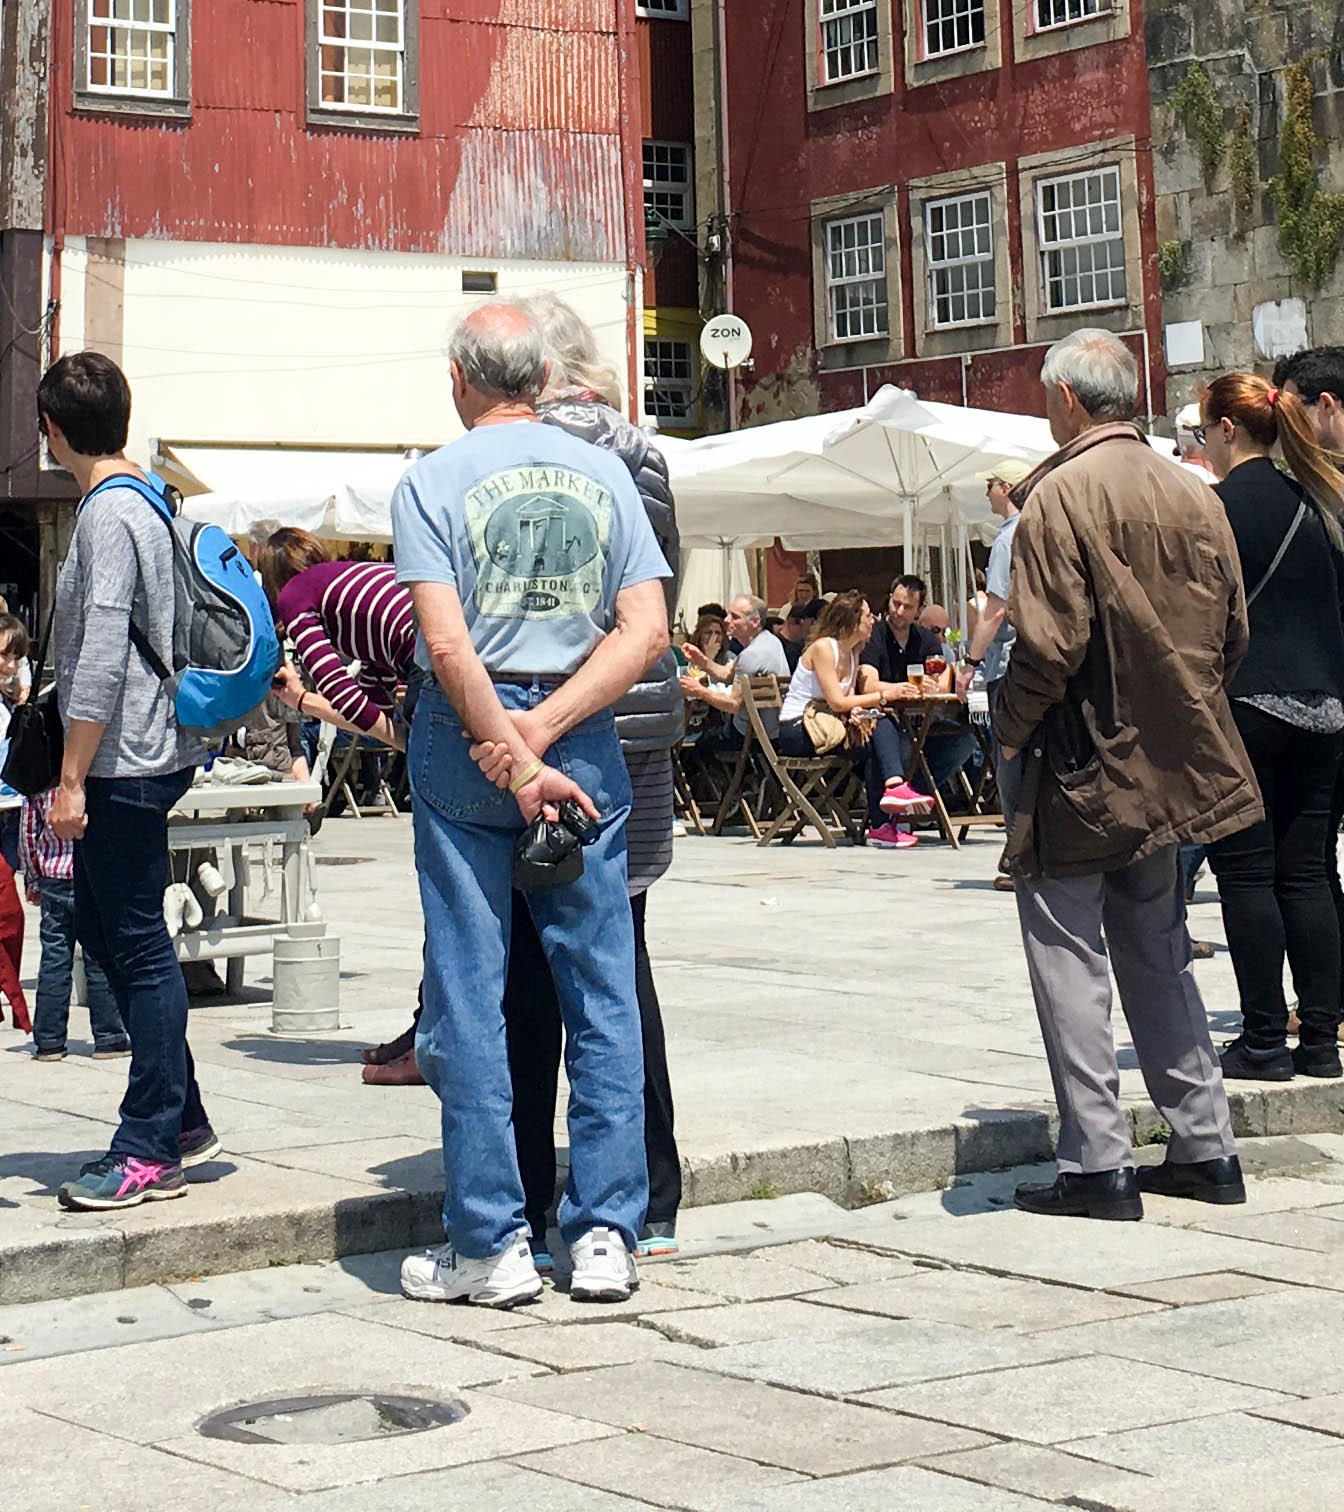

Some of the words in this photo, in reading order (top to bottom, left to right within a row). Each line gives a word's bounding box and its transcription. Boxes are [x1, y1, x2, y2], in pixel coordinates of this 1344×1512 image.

[711, 328, 741, 338] ZON
[468, 474, 514, 506] THE
[519, 470, 609, 506] MARKET
[536, 596, 555, 607] 1841
